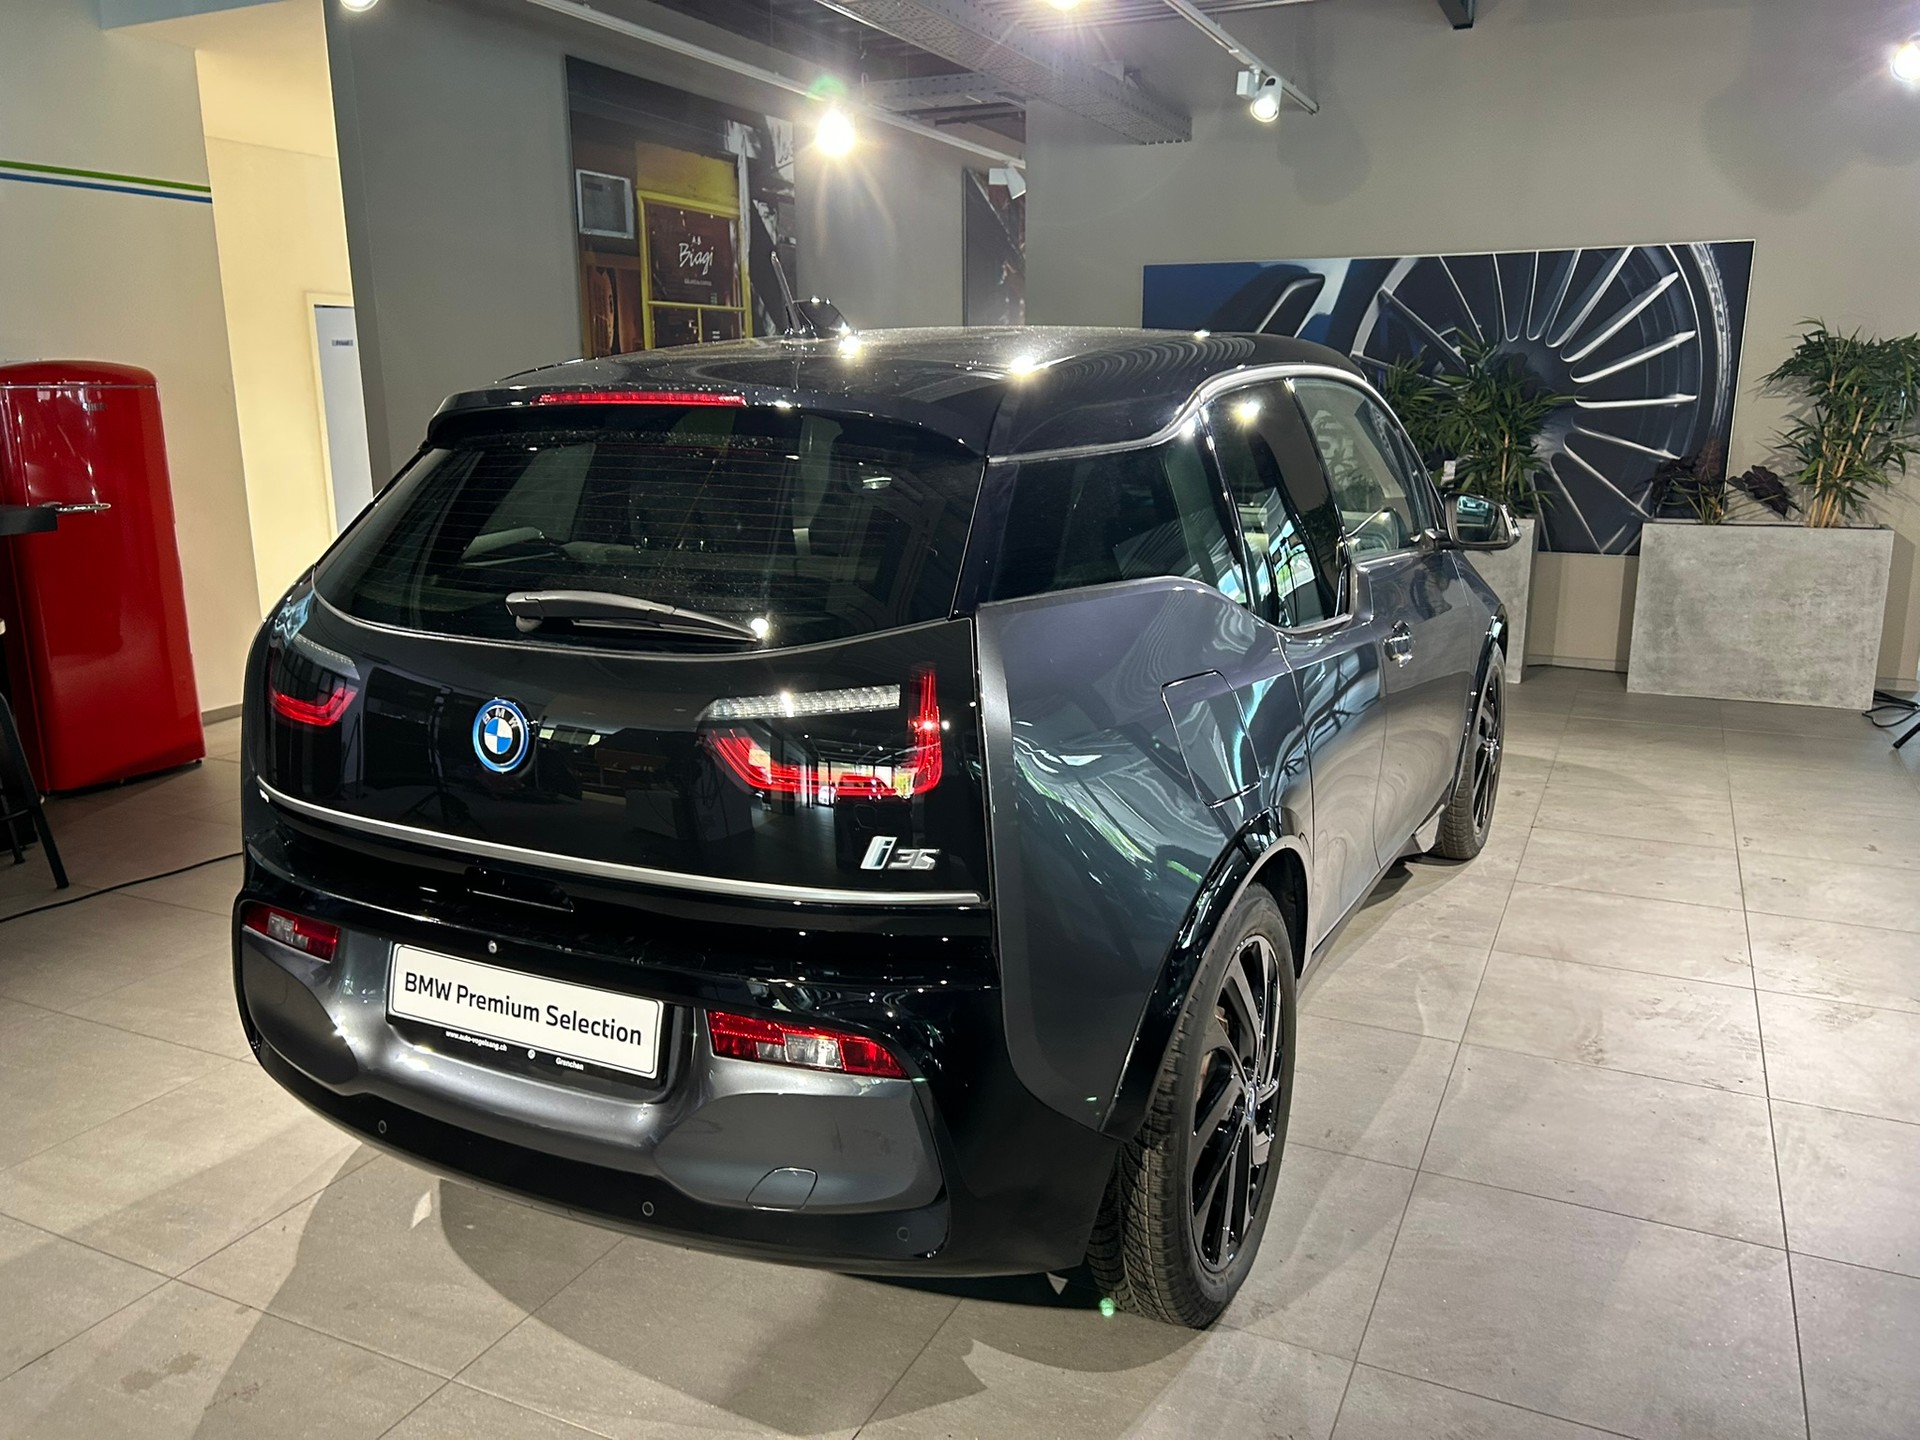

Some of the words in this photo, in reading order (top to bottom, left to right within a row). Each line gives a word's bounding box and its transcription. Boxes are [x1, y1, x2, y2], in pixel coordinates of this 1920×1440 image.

[679, 242, 715, 276] Biagi
[482, 707, 519, 729] BMW
[404, 971, 452, 1001] BMW
[456, 983, 540, 1023] Premium
[545, 1004, 642, 1046] Selection
